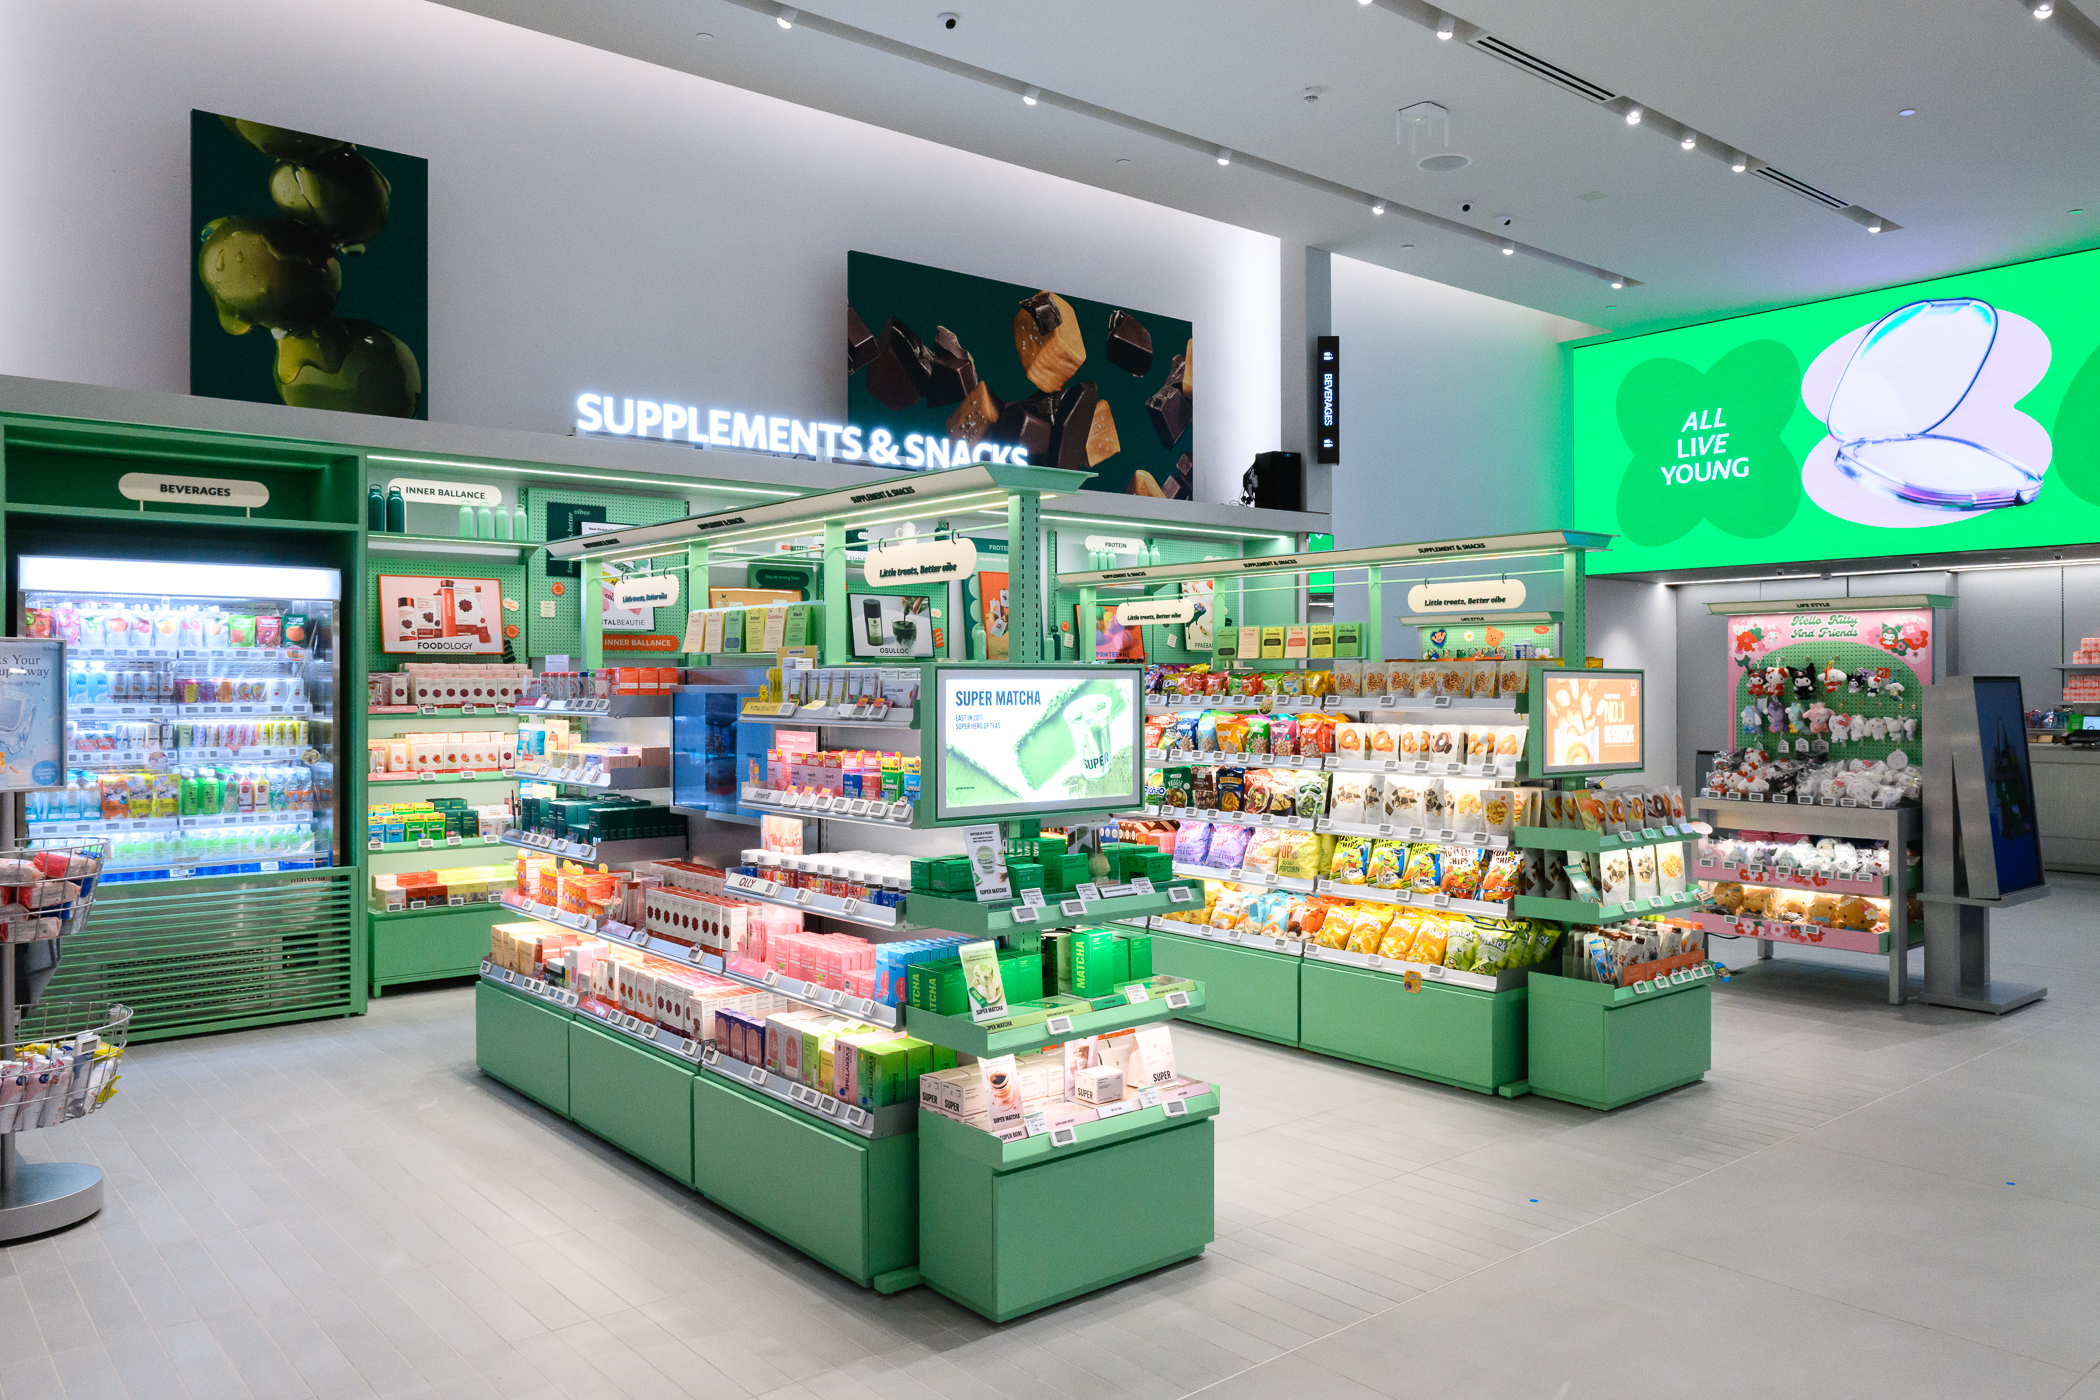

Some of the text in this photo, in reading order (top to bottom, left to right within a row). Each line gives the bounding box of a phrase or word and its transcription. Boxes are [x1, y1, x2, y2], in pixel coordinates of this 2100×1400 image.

[1323, 373, 1333, 427] BEVERAGES
[1681, 407, 1726, 433] ALL
[577, 392, 1029, 469] SUPPLEMENTS & SNACKS
[1677, 433, 1730, 459] LIVE
[1660, 457, 1749, 486] YOUNG
[160, 484, 231, 498] BEVERAGES
[405, 486, 485, 500] INNER BALLANCE
[1417, 545, 1453, 554] SUPPLEMENT
[1462, 542, 1486, 551] SNACKS
[879, 567, 896, 578] Little
[897, 566, 919, 576] treats,
[920, 564, 941, 575] Better
[1424, 595, 1506, 607] Little treats, Better vibe
[1791, 614, 1858, 628] Hello Kitty
[1790, 627, 1858, 639] And Friends
[417, 641, 473, 650] FOODOLOGY
[604, 638, 671, 647] INNER BALLANCE
[12, 654, 40, 665] Your
[955, 690, 1041, 706] SUPER MATCHA
[955, 714, 966, 722] EAST
[1603, 701, 1625, 723] NO.1
[955, 722, 970, 730] SUPER
[971, 722, 983, 730] HERO
[984, 722, 990, 730] OF
[1082, 752, 1109, 770] SUPER
[738, 877, 756, 888] OLLY
[1458, 926, 1475, 942] Kick
[1536, 932, 1550, 947] ick
[1485, 935, 1507, 952] Kick
[1075, 941, 1086, 989] MATCHA
[912, 973, 920, 1008] ATCHA
[928, 978, 937, 1013] ATCHA
[975, 1005, 1004, 1016] SUPER MATCHA
[996, 1020, 1013, 1029] MATCHA
[1152, 1070, 1172, 1083] SUPER
[922, 1091, 938, 1105] SUPER
[1077, 1087, 1094, 1100] SUPER
[944, 1098, 959, 1112] SUPER
[993, 1113, 1020, 1124] SUPER MATCHA
